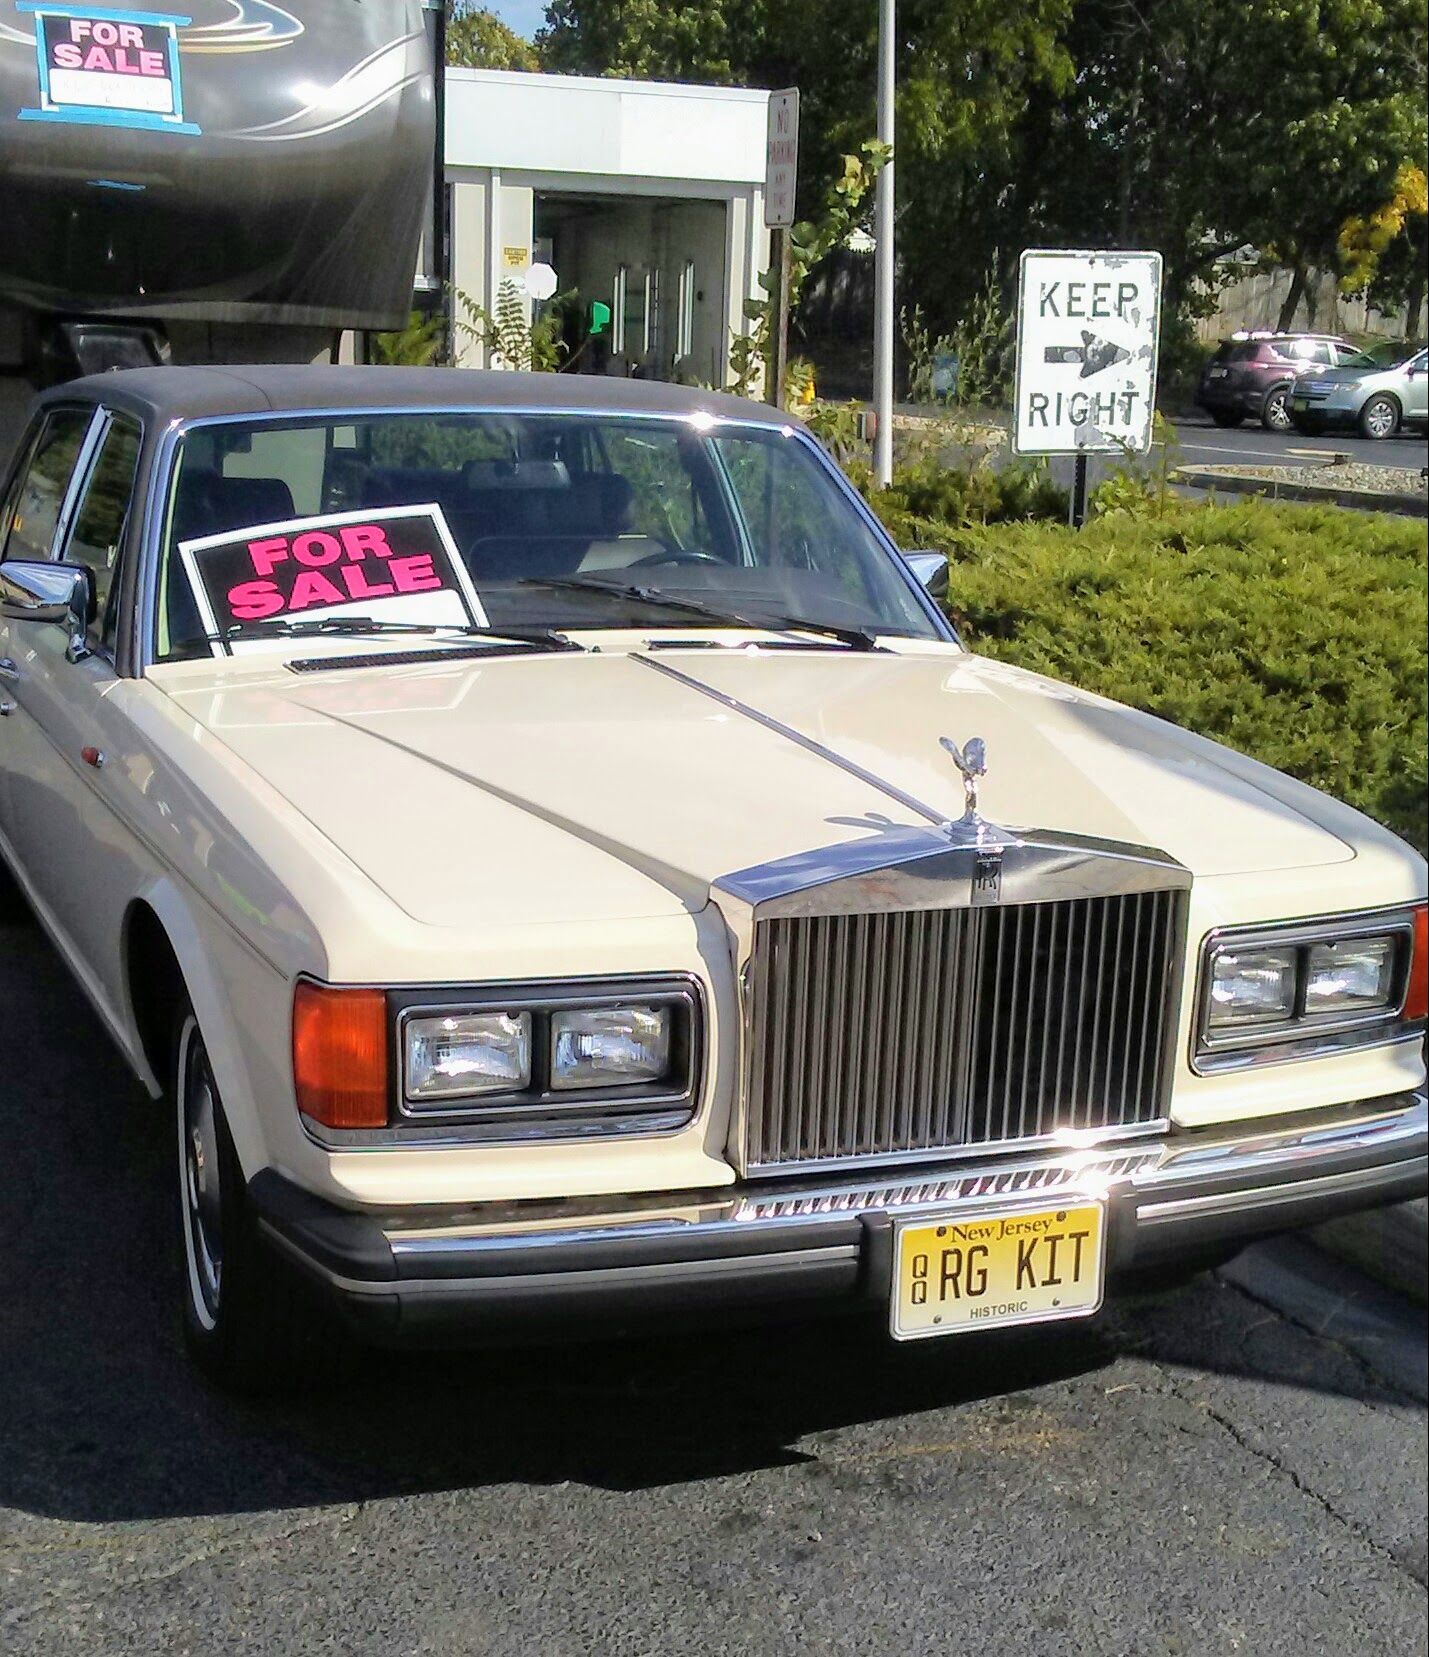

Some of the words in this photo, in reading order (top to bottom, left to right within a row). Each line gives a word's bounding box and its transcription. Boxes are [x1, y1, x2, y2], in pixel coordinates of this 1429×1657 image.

[69, 19, 145, 48] FOR
[53, 43, 166, 76] SALE
[1039, 282, 1139, 318] KEEP
[1028, 391, 1140, 427] RIGHT
[248, 525, 393, 576] FOR
[227, 553, 442, 621] SALE
[951, 1224, 995, 1243] New
[997, 1217, 1053, 1241] Jersey
[939, 1244, 989, 1301] RG
[1016, 1230, 1090, 1290] KIT
[970, 1301, 1028, 1319] HISTORIC
